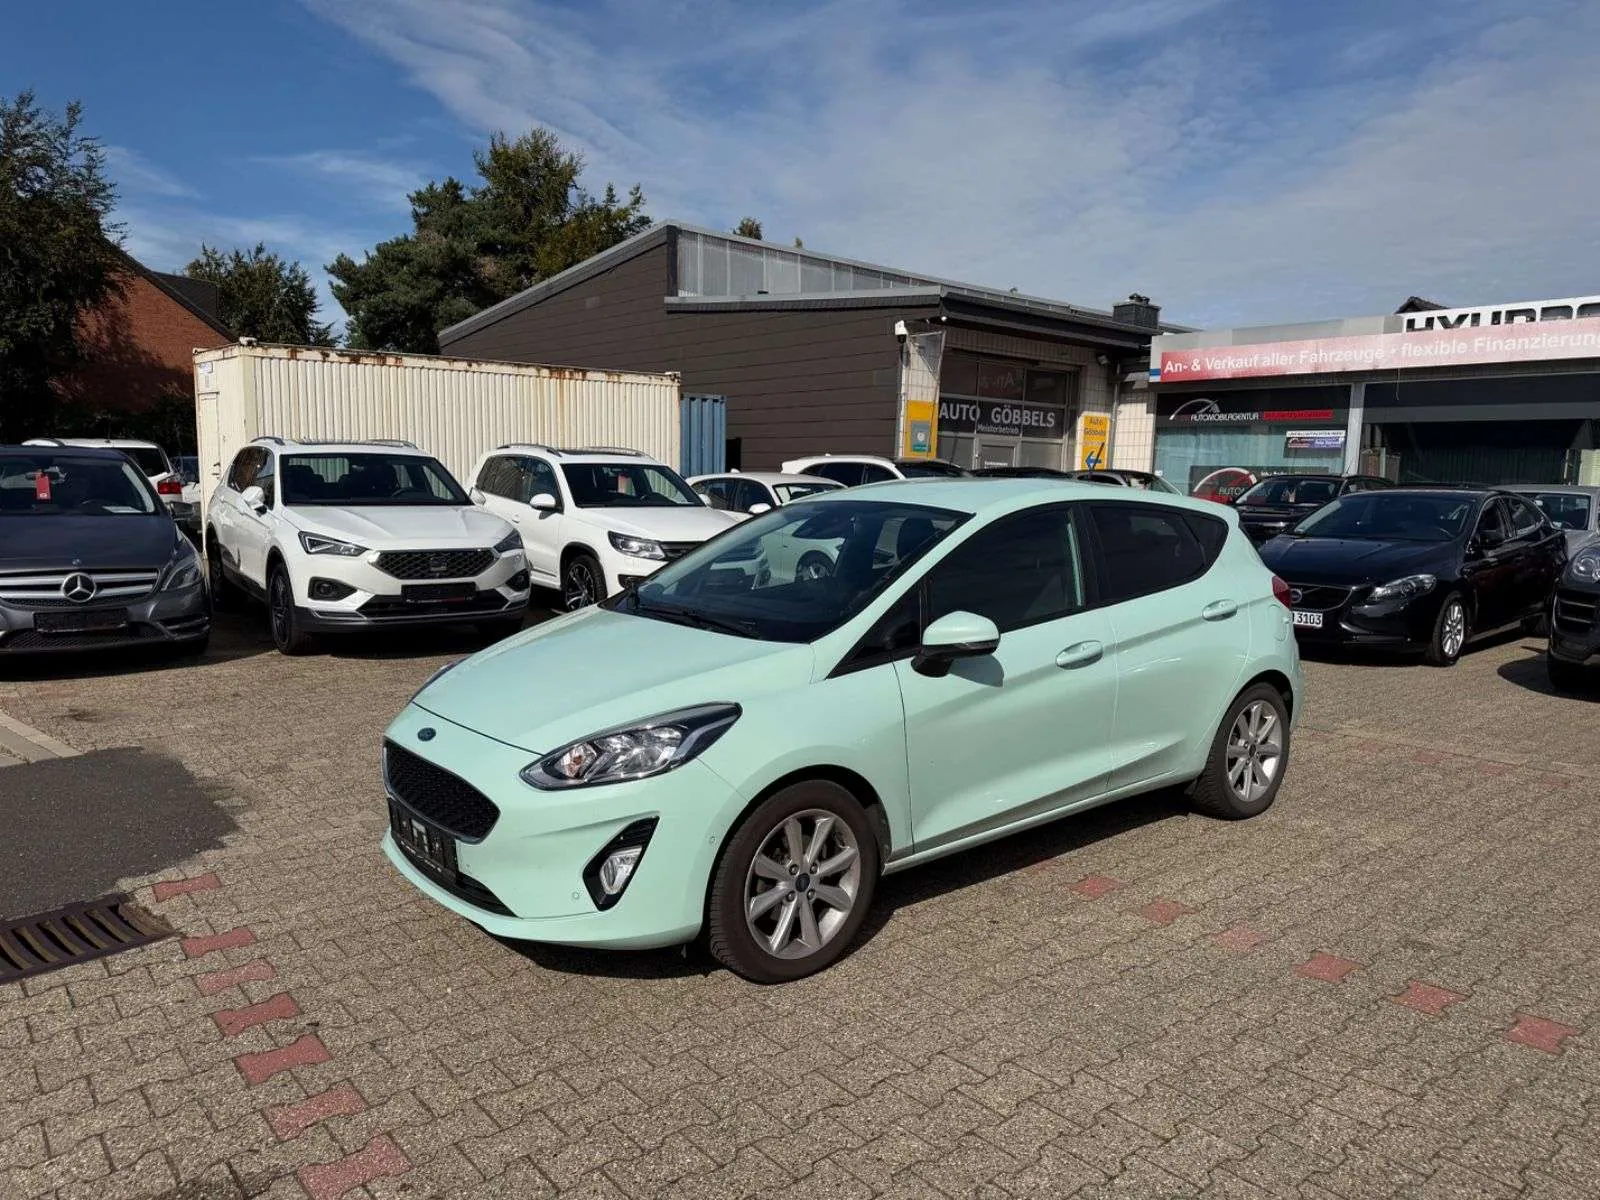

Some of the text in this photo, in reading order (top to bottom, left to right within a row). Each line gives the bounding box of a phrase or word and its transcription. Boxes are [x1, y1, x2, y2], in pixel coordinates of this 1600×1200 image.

[1164, 360, 1188, 373] An-
[1191, 358, 1201, 372] &
[1206, 354, 1259, 370] Verkauf
[1262, 351, 1297, 366] aller
[1300, 347, 1385, 365] Fahrzeuge
[1401, 338, 1469, 358] flexible
[939, 402, 1056, 428] AUTO GÖBBELS
[1297, 612, 1322, 625] 3103
